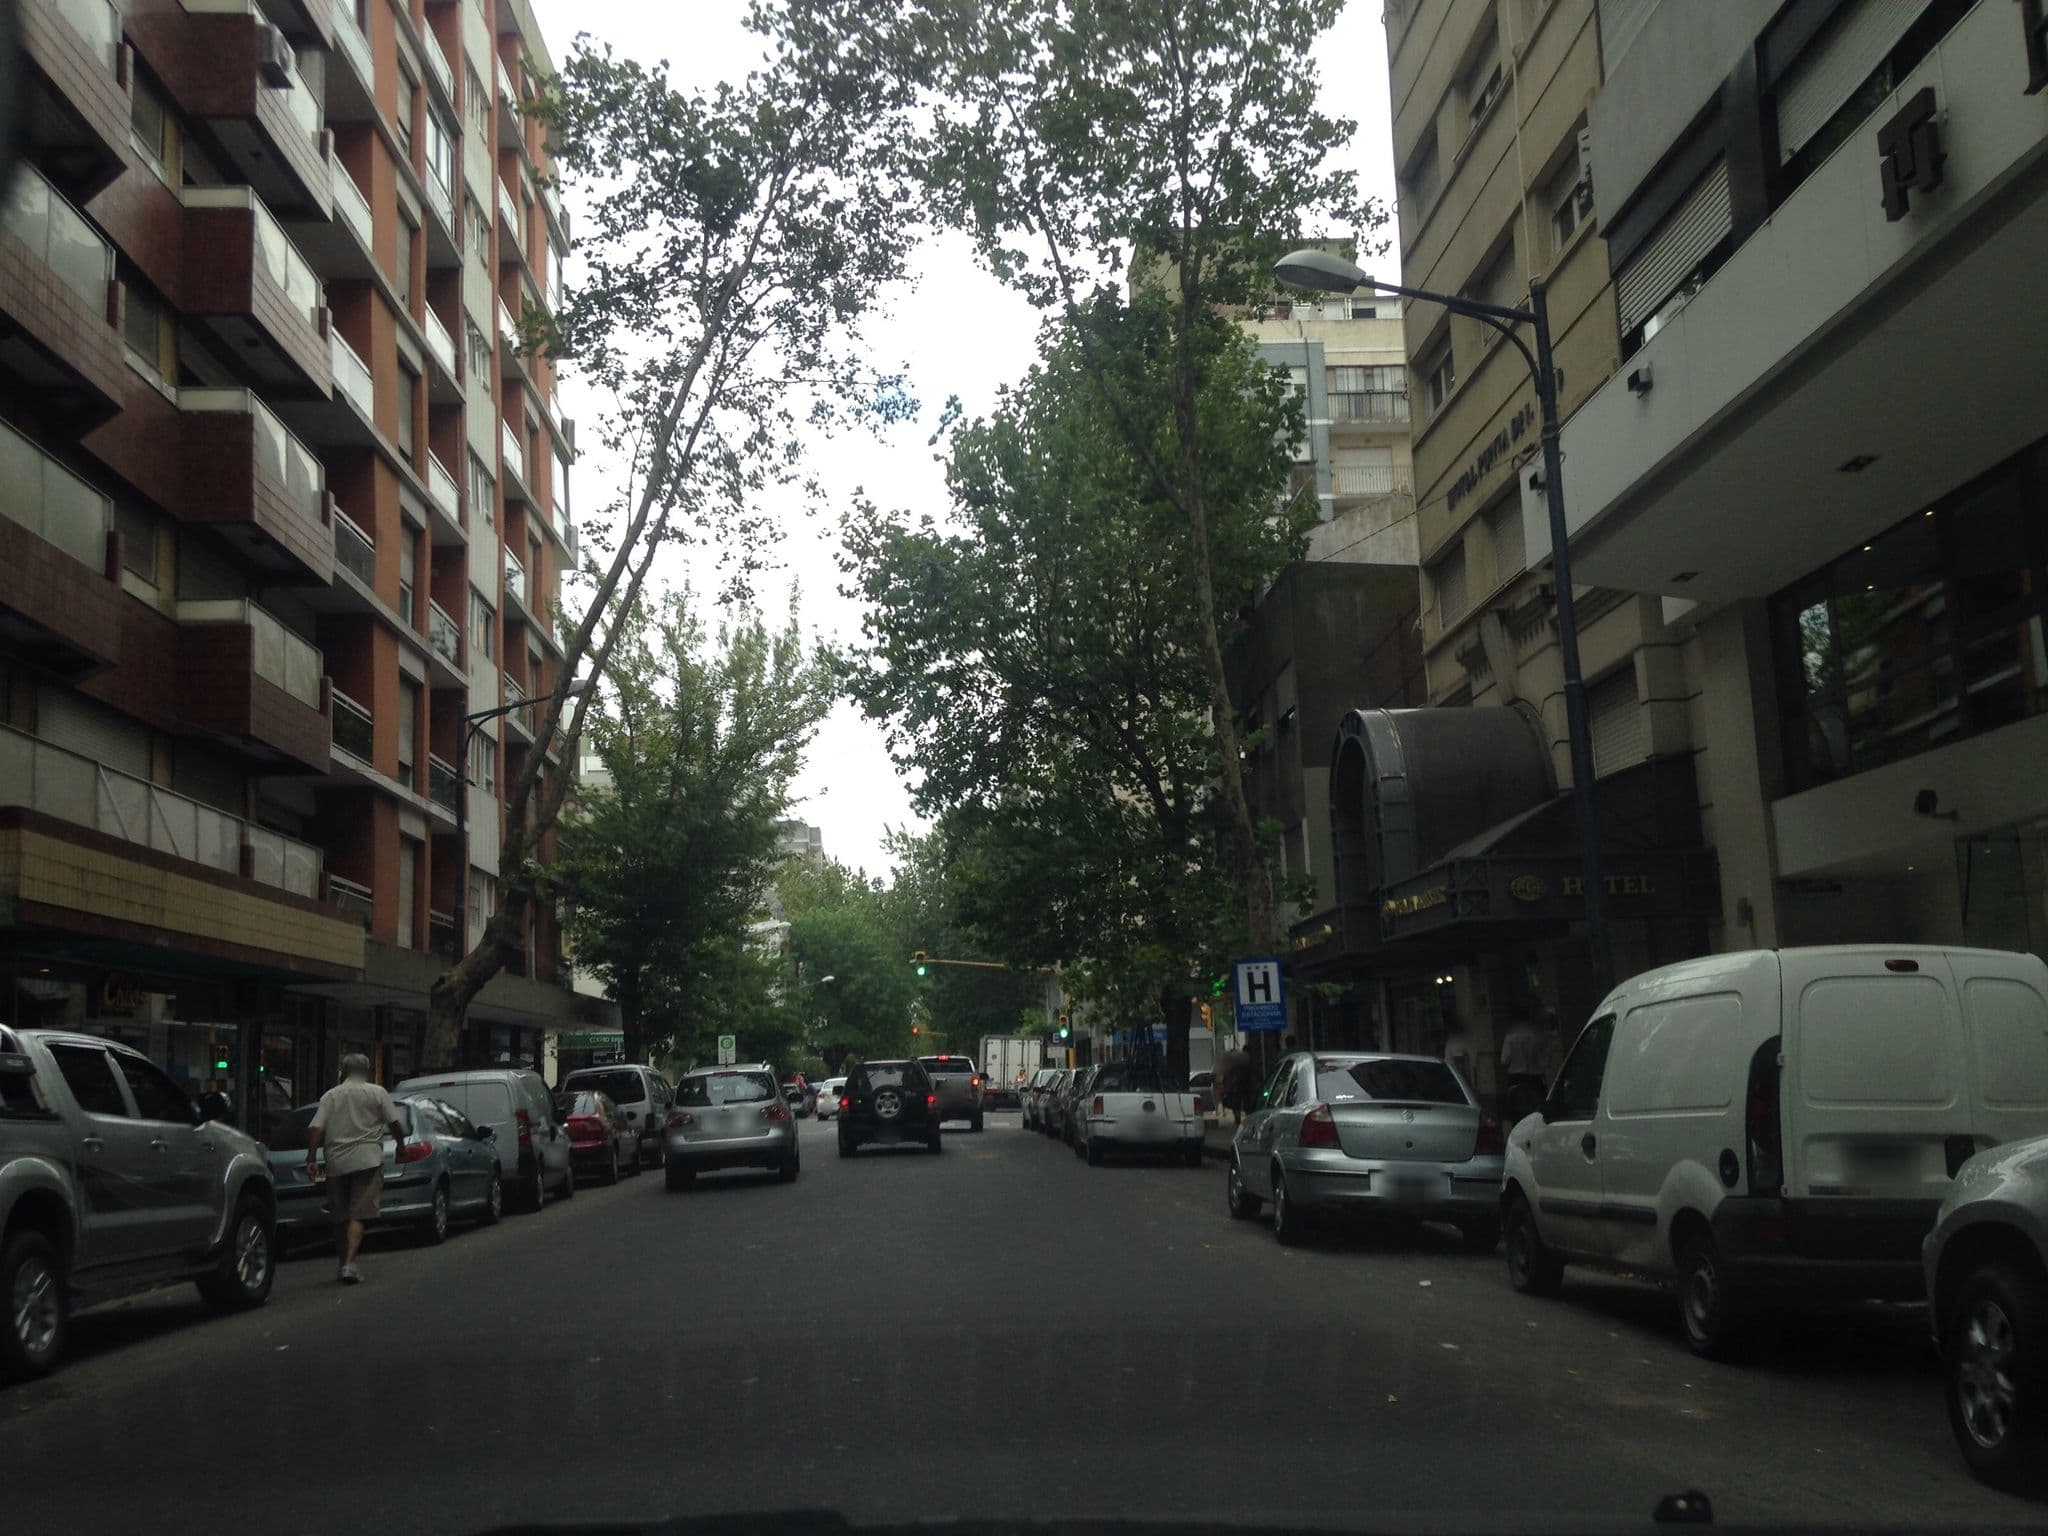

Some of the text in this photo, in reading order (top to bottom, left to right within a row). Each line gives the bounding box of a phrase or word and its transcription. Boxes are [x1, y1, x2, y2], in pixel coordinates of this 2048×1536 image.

[1447, 466, 1478, 511] HOTEL
[1562, 873, 1656, 896] HTEL
[1247, 971, 1271, 1002] H
